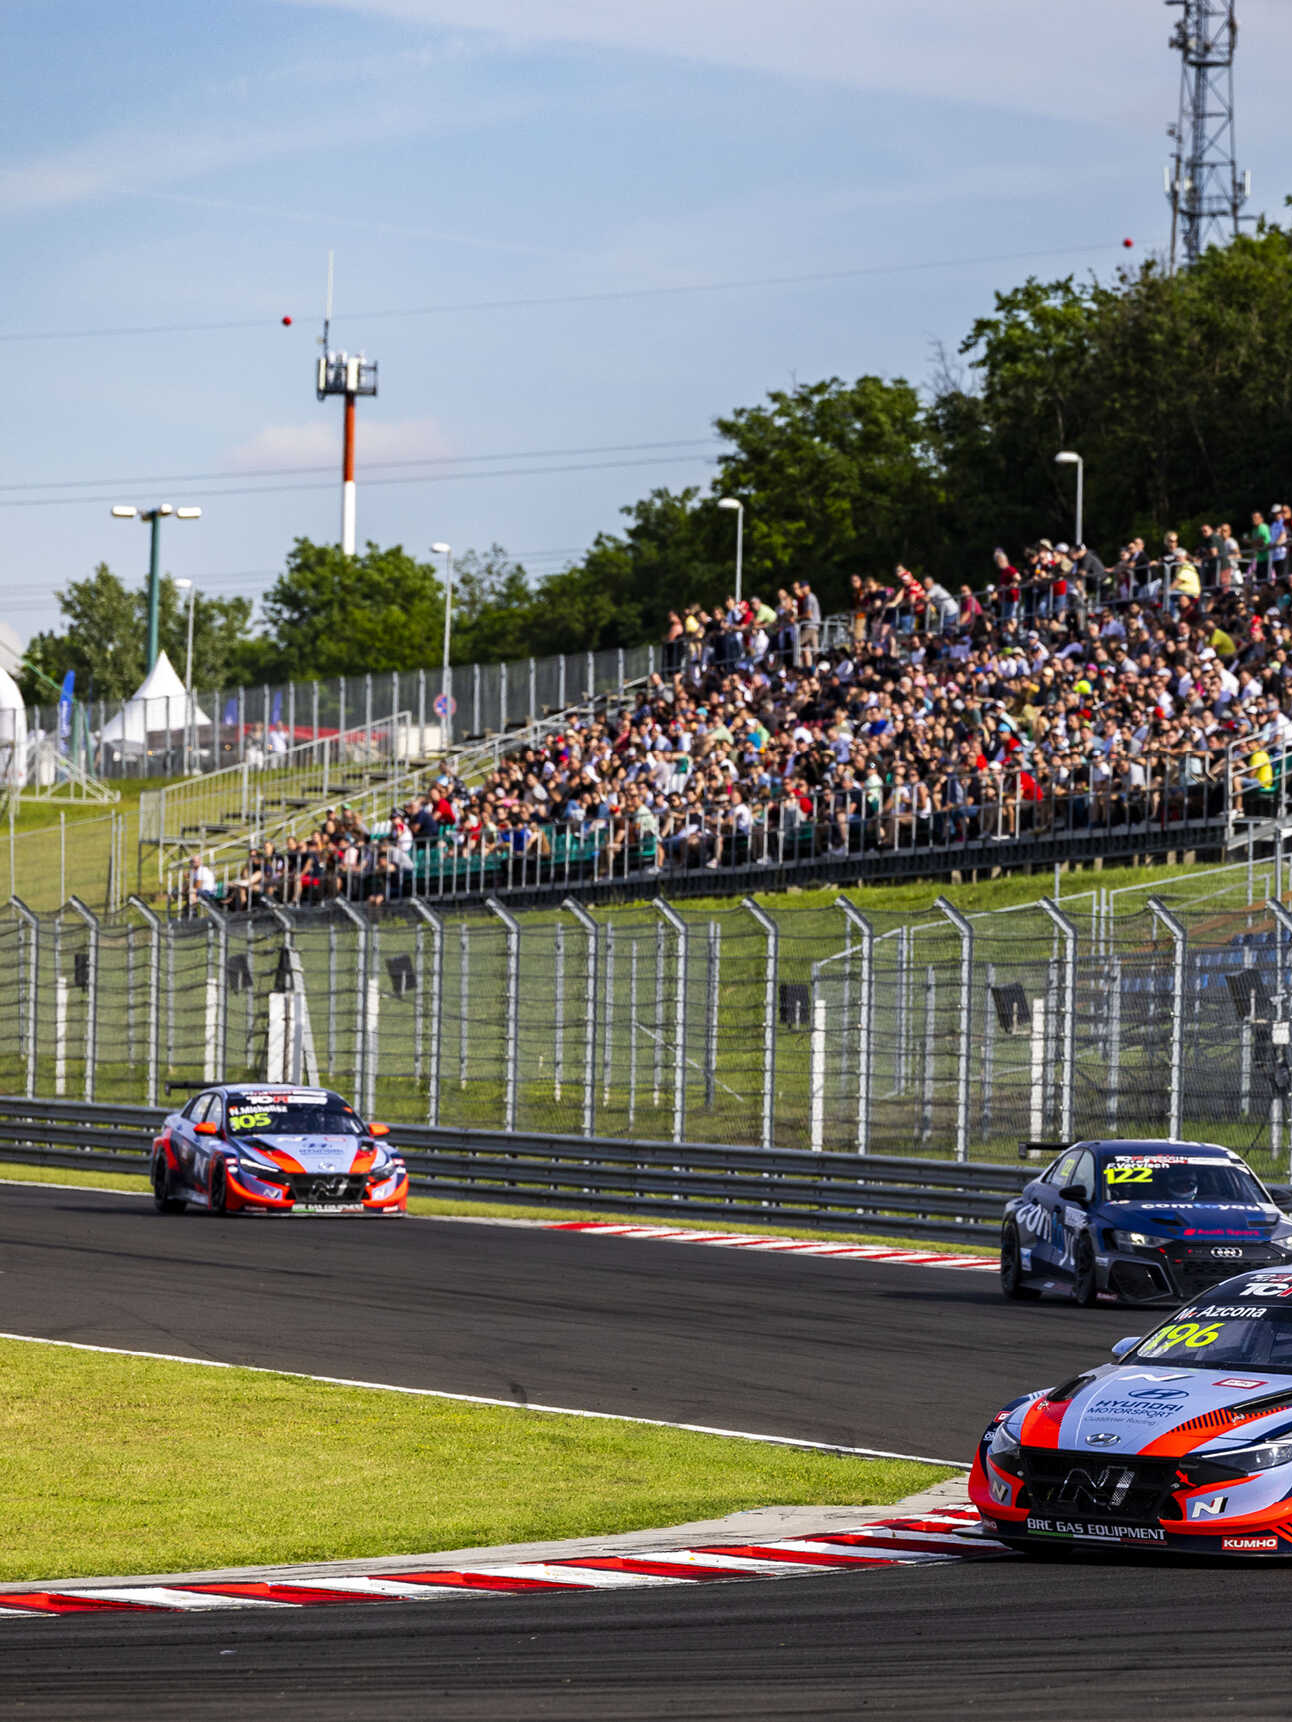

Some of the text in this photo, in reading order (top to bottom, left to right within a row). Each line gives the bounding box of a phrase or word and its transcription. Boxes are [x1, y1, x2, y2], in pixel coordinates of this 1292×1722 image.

[230, 1112, 272, 1131] 105
[1103, 1167, 1153, 1185] 122
[1197, 1304, 1268, 1318] Azcona
[1145, 1322, 1225, 1351] 196
[1086, 1407, 1175, 1419] MOTORSPORT
[1095, 1399, 1185, 1412] HYUNDAI
[1026, 1517, 1166, 1541] BRC GAS EQUIPMENT
[1223, 1538, 1277, 1548] KUMHO
